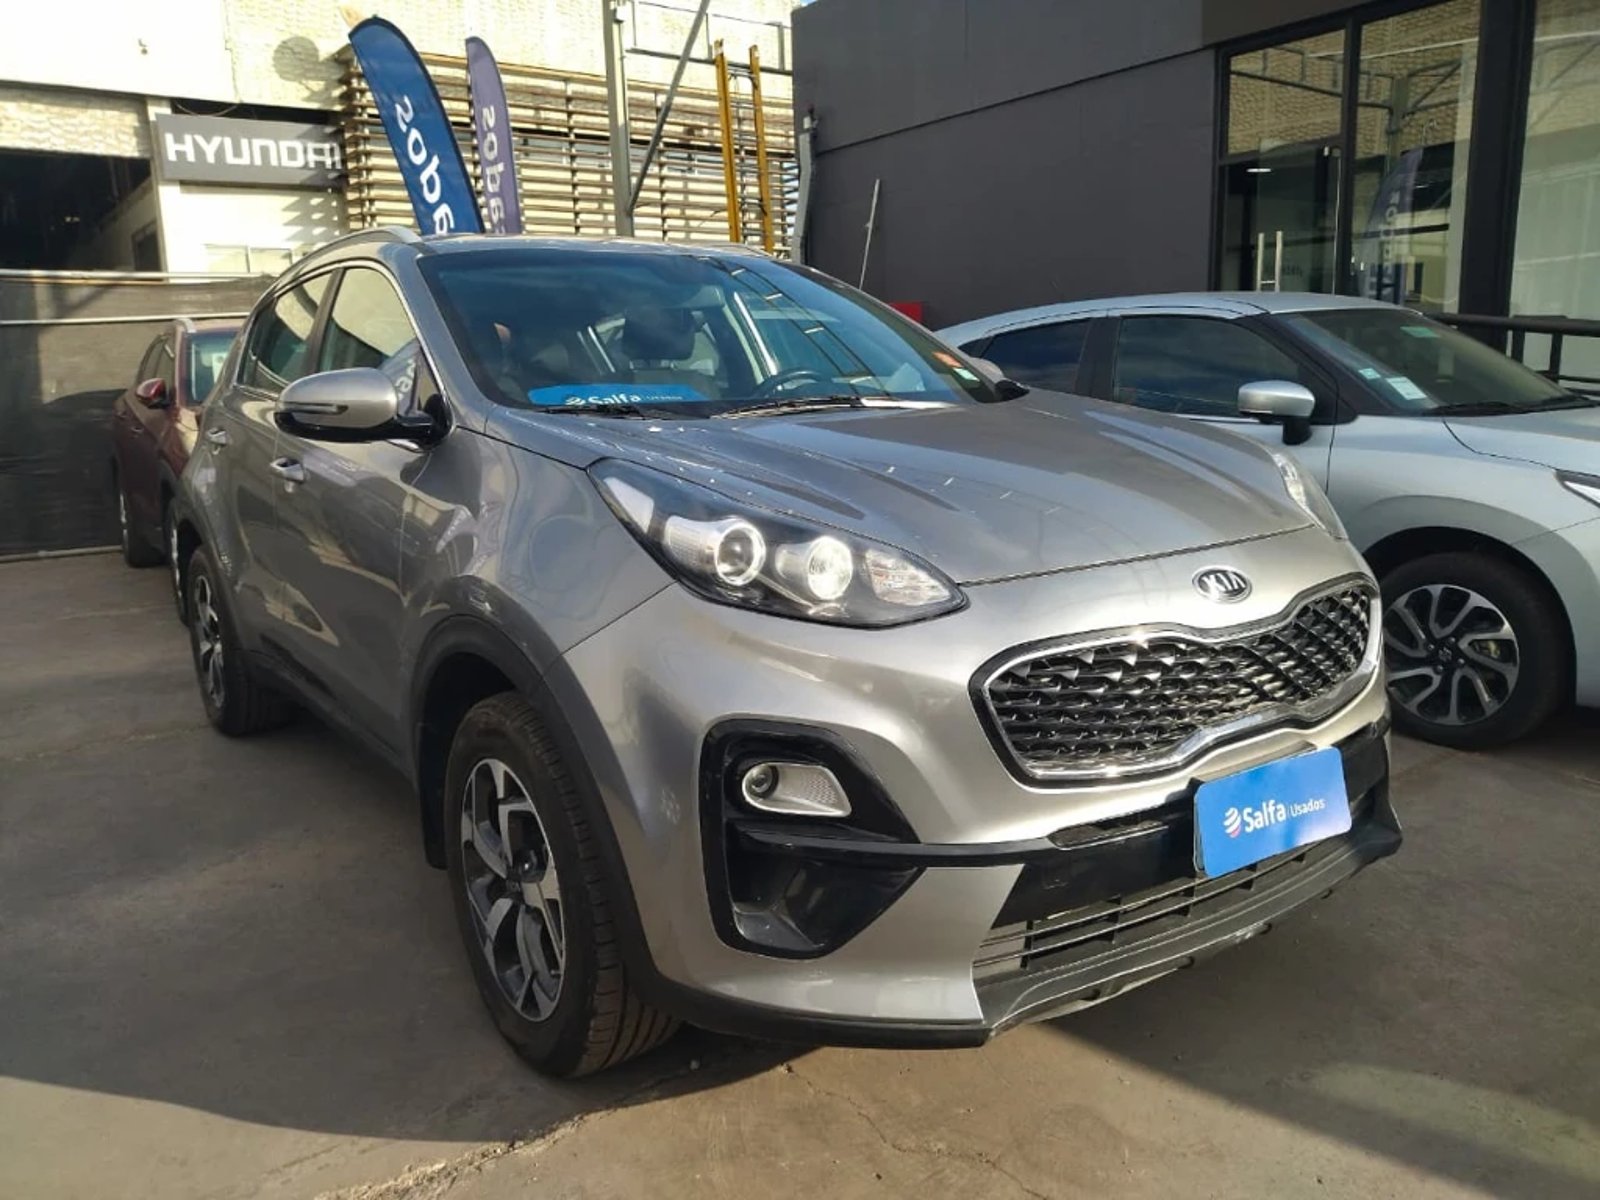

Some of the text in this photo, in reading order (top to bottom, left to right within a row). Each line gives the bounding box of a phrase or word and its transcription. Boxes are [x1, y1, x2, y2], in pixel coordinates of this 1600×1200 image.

[164, 132, 343, 170] HYUNDAI
[1201, 572, 1246, 597] KIA
[1243, 798, 1325, 832] Salfa Usados
